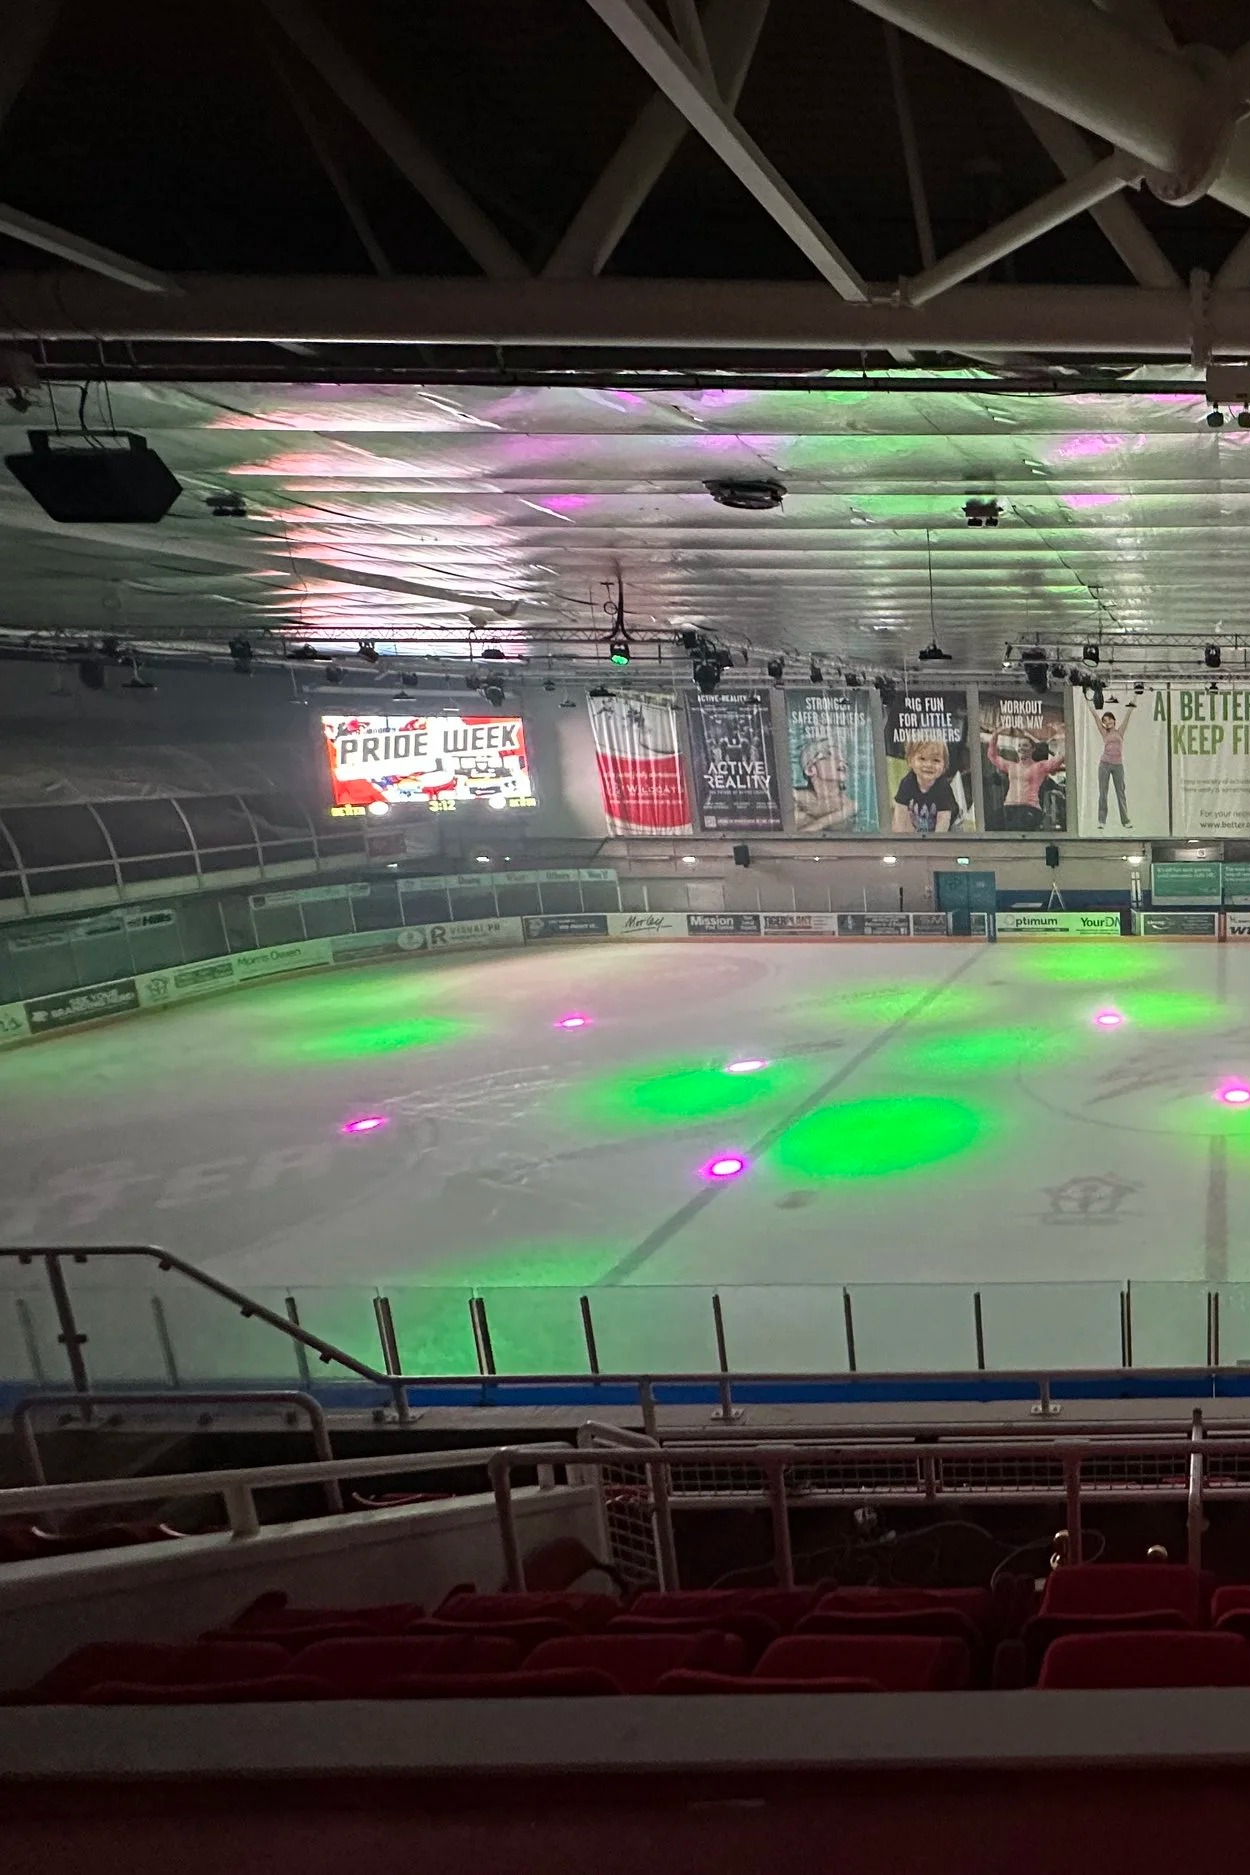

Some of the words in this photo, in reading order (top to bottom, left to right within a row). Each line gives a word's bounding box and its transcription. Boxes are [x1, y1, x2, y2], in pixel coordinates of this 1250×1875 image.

[925, 697, 944, 712] FUN
[1000, 700, 1042, 714] WORKOUT
[1153, 691, 1166, 721] A
[899, 713, 917, 727] FOR
[921, 713, 952, 727] LITTLE
[1000, 716, 1024, 729] YOUR
[1026, 716, 1043, 729] WAY
[893, 728, 961, 743] ADVENTURERS
[1172, 724, 1225, 755] KEEP
[340, 732, 428, 764] PRIDE
[443, 724, 516, 754] WEEK
[707, 761, 765, 775] ACTIVE
[703, 774, 771, 789] REALITY
[624, 914, 664, 932] Morley
[690, 915, 734, 926] Mission
